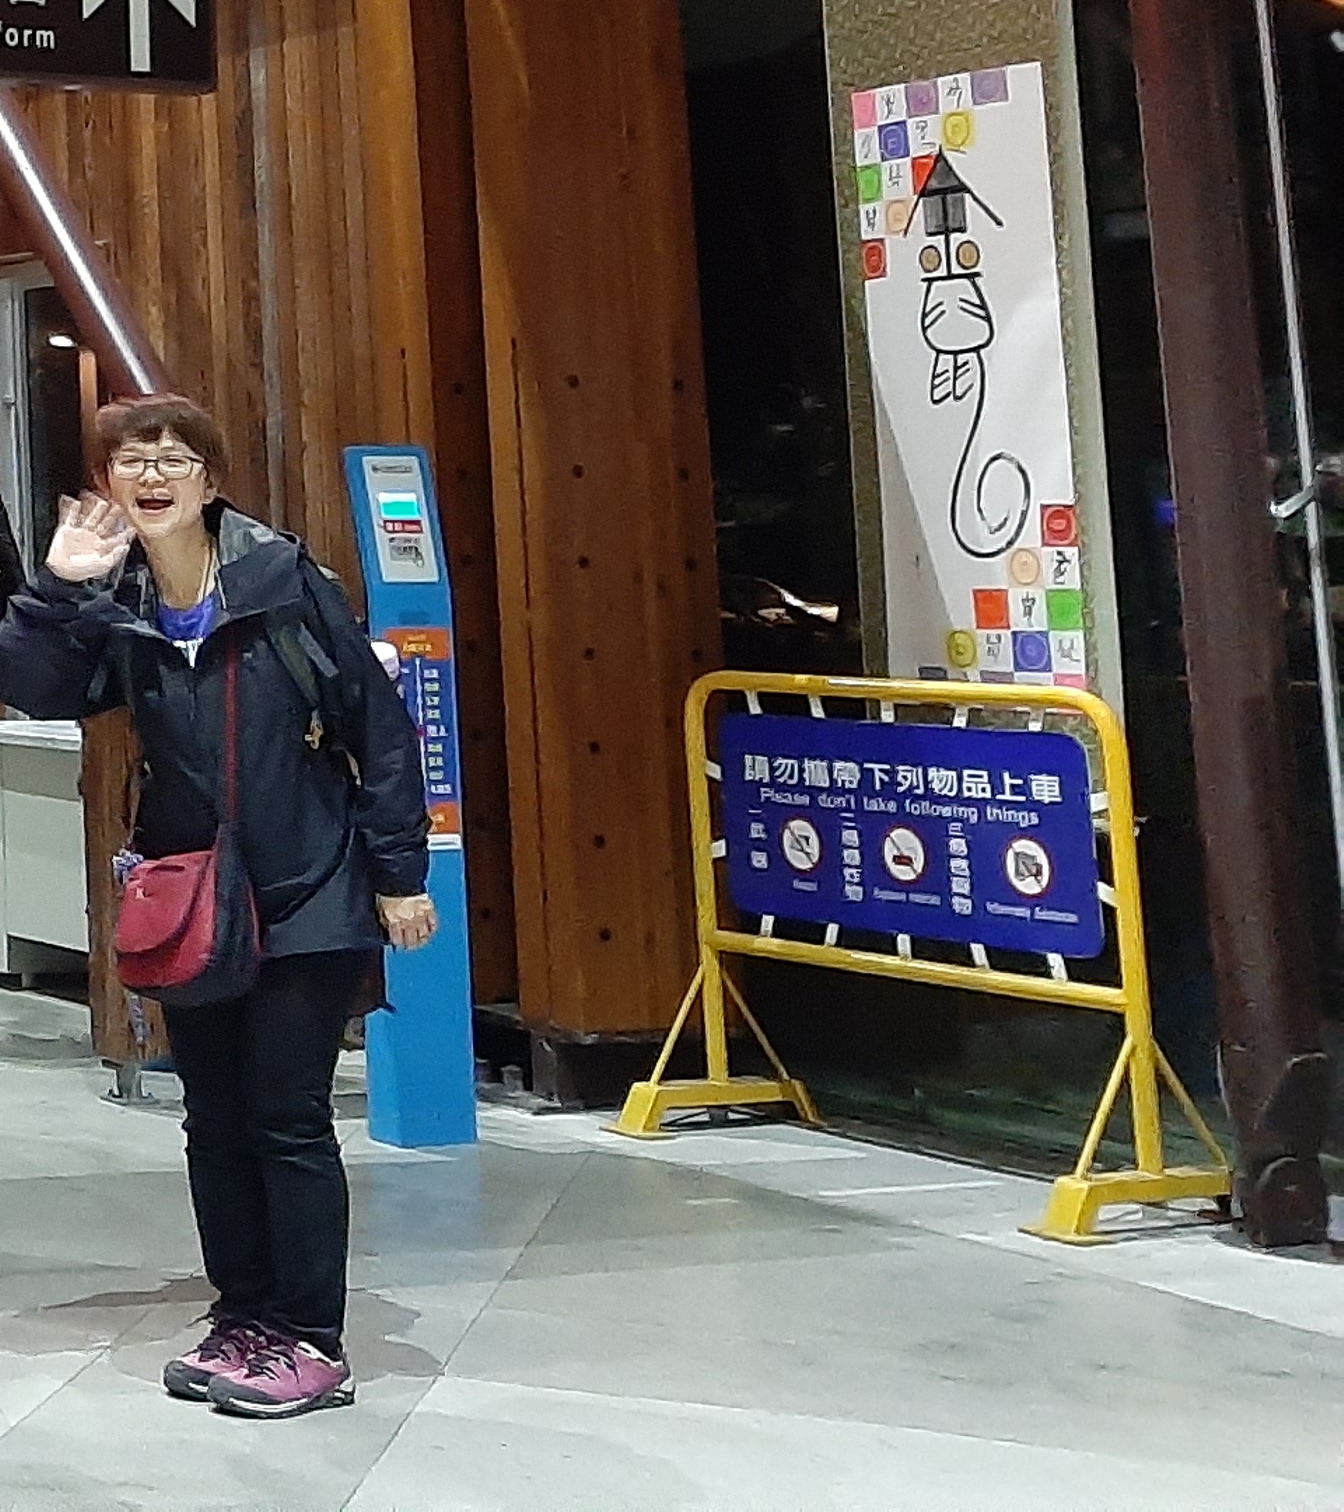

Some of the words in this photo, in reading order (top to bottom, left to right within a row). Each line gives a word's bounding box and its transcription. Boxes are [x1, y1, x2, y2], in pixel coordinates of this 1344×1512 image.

[743, 754, 1063, 804] 請勿攜帶下列物品上車
[760, 788, 810, 805] Please
[863, 796, 897, 813] take
[904, 799, 978, 823] following
[987, 805, 1040, 828] things
